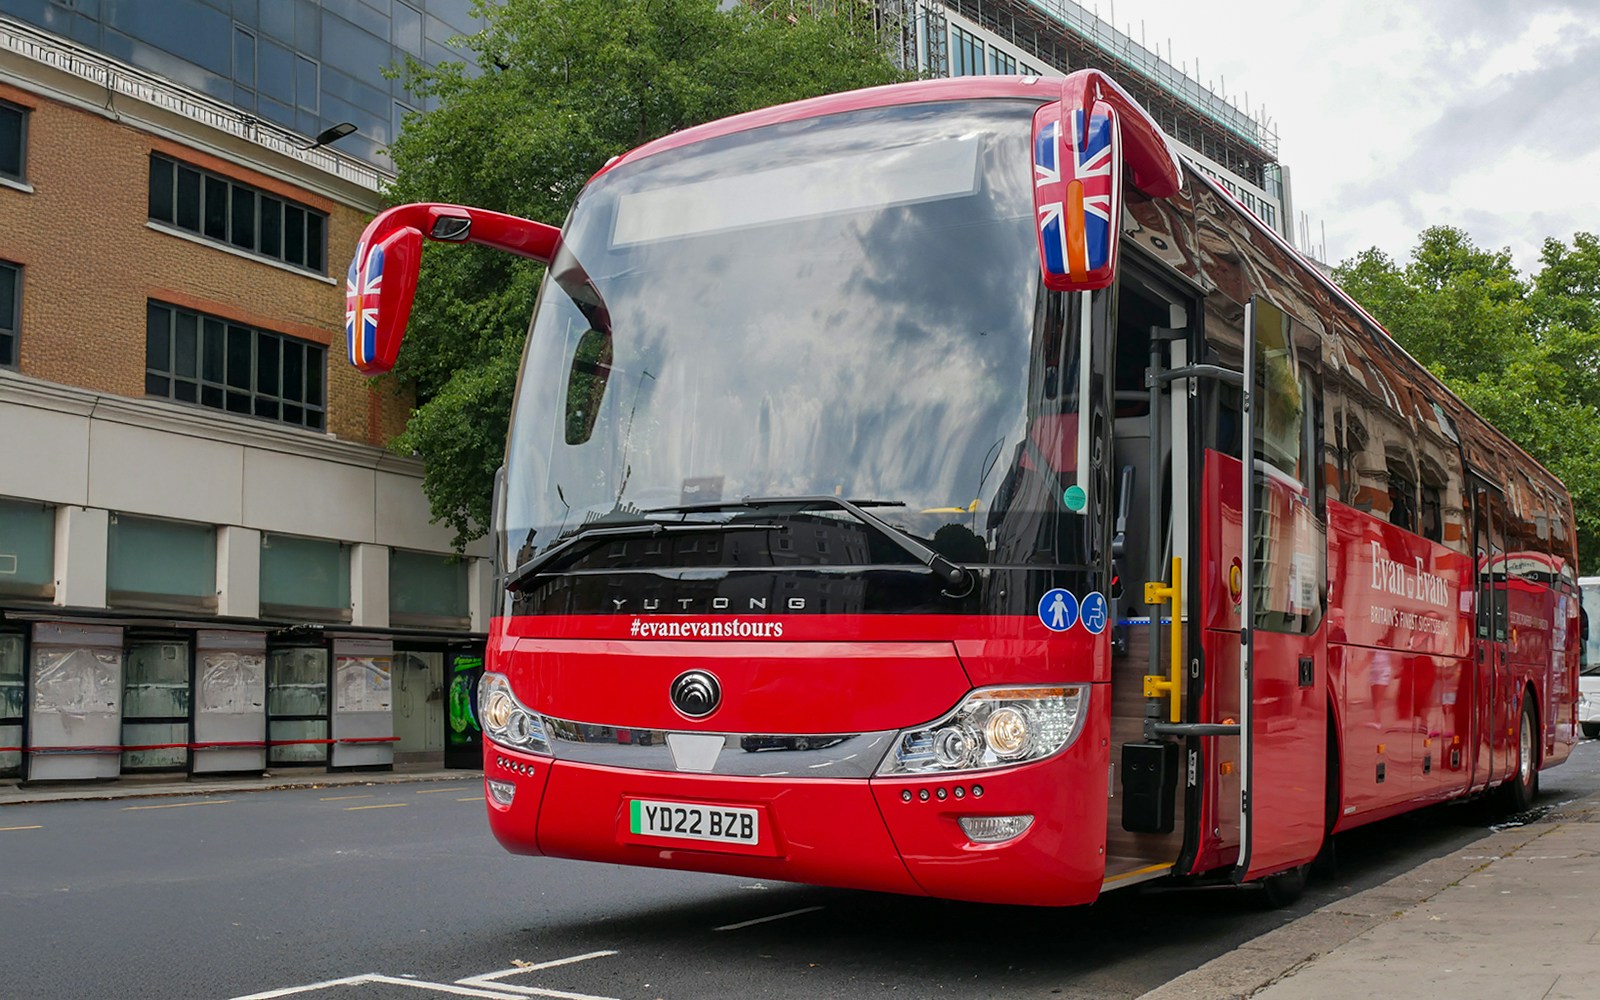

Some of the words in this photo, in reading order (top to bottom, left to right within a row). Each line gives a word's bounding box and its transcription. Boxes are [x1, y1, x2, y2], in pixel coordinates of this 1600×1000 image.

[1370, 540, 1405, 596] Evan
[1415, 556, 1449, 608] Evans
[613, 597, 805, 609] YUTONG
[630, 618, 783, 637] #evanevanstours
[1370, 605, 1399, 627] BRITAIN'S
[1400, 611, 1418, 630] FINEST
[645, 805, 702, 834] YD22
[709, 810, 753, 839] BZB
